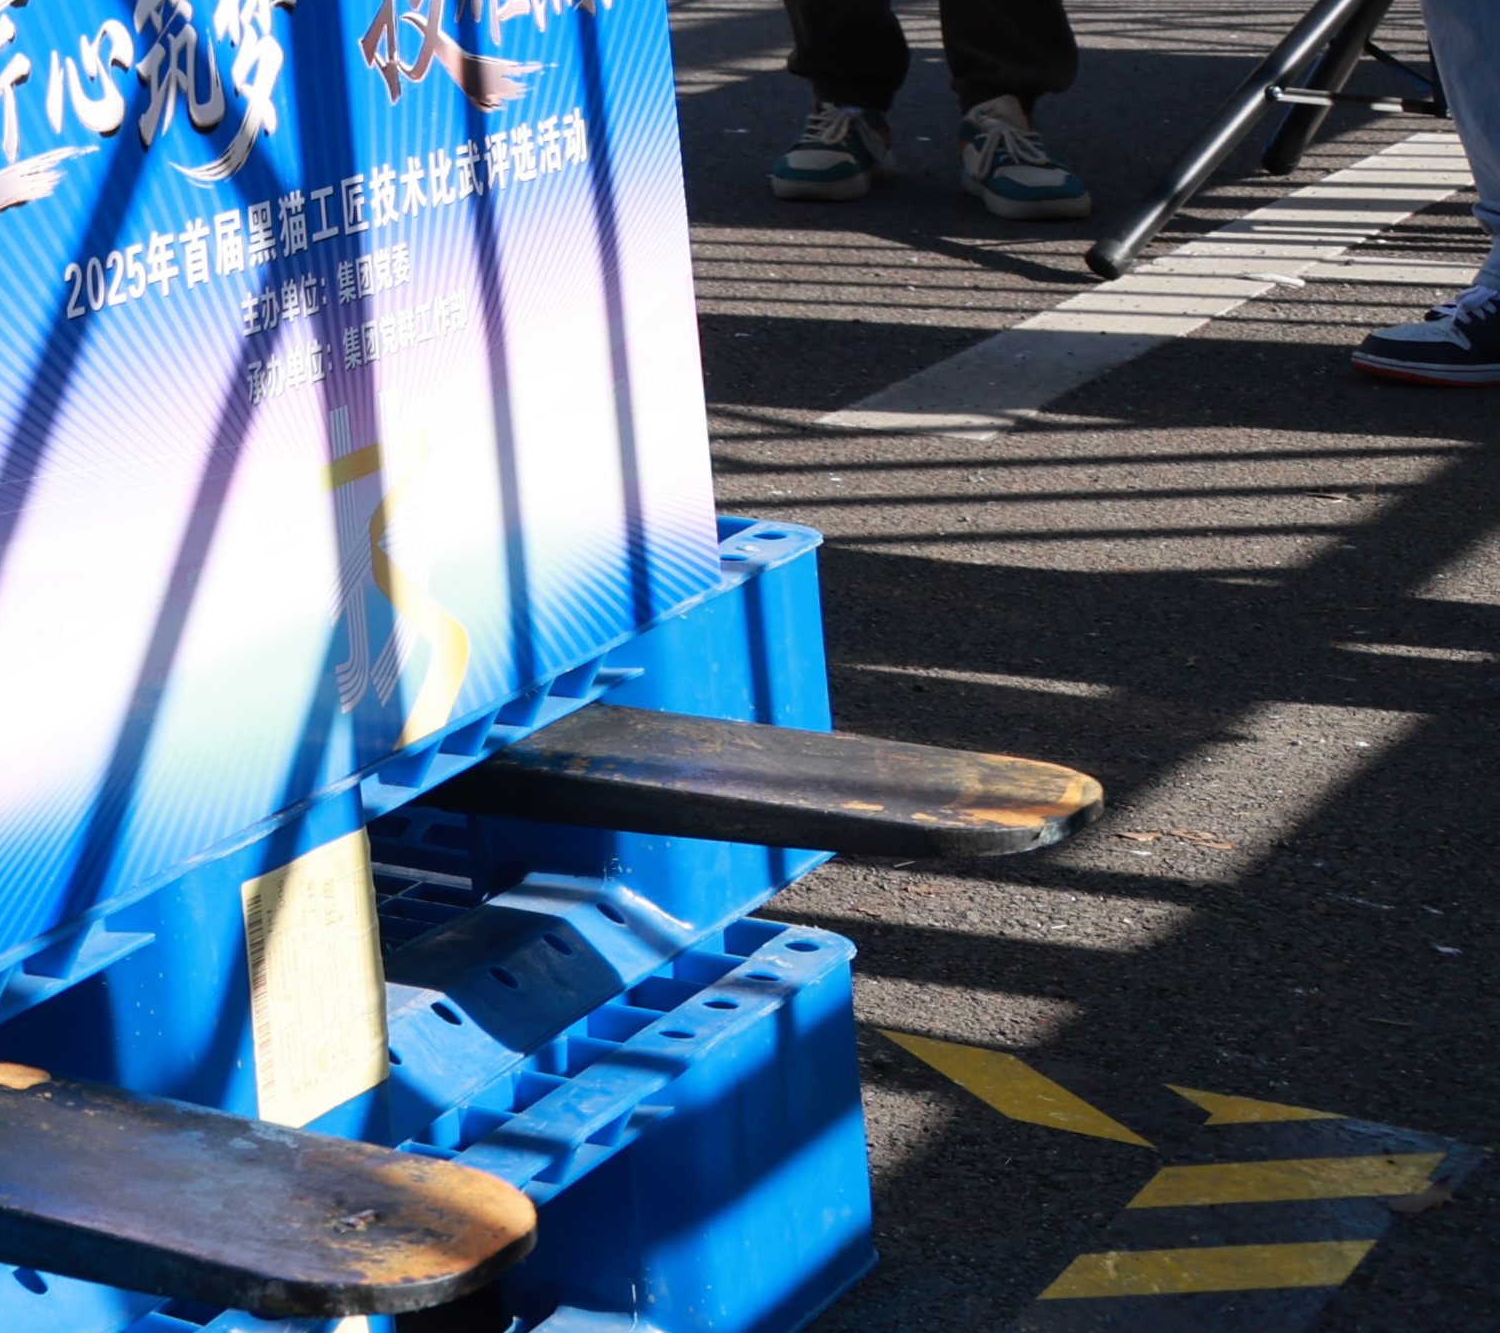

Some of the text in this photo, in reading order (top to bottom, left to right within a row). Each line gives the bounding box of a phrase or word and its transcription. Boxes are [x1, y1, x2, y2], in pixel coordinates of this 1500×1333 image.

[64, 106, 590, 320] 2025年首届黑猫工匠技术比武评选活动
